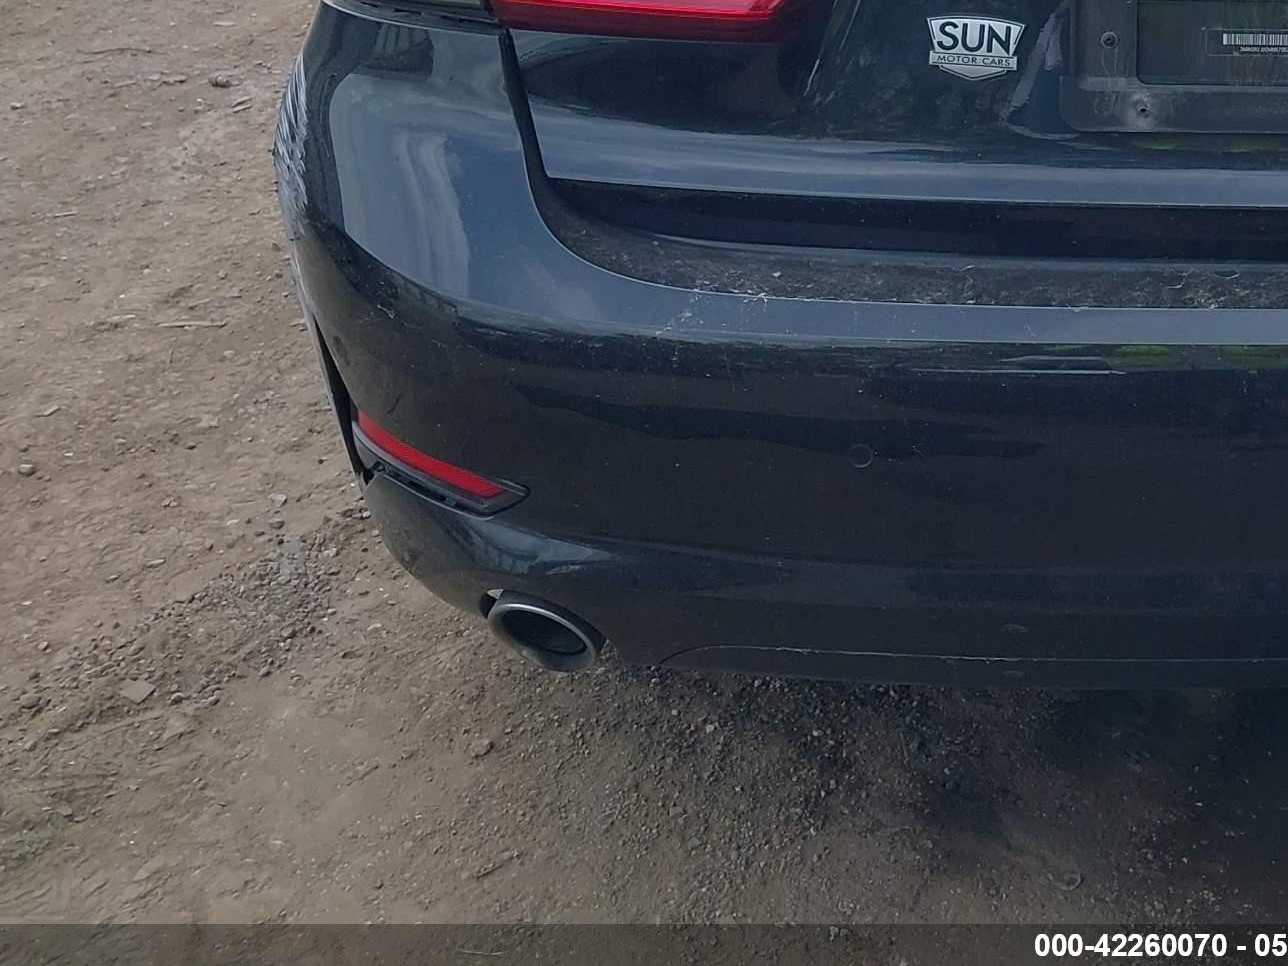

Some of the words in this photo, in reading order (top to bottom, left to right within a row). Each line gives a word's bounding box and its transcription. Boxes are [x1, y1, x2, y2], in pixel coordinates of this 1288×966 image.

[937, 21, 1012, 56] SUN
[936, 54, 978, 65] MOTOR
[982, 57, 1011, 67] CARS
